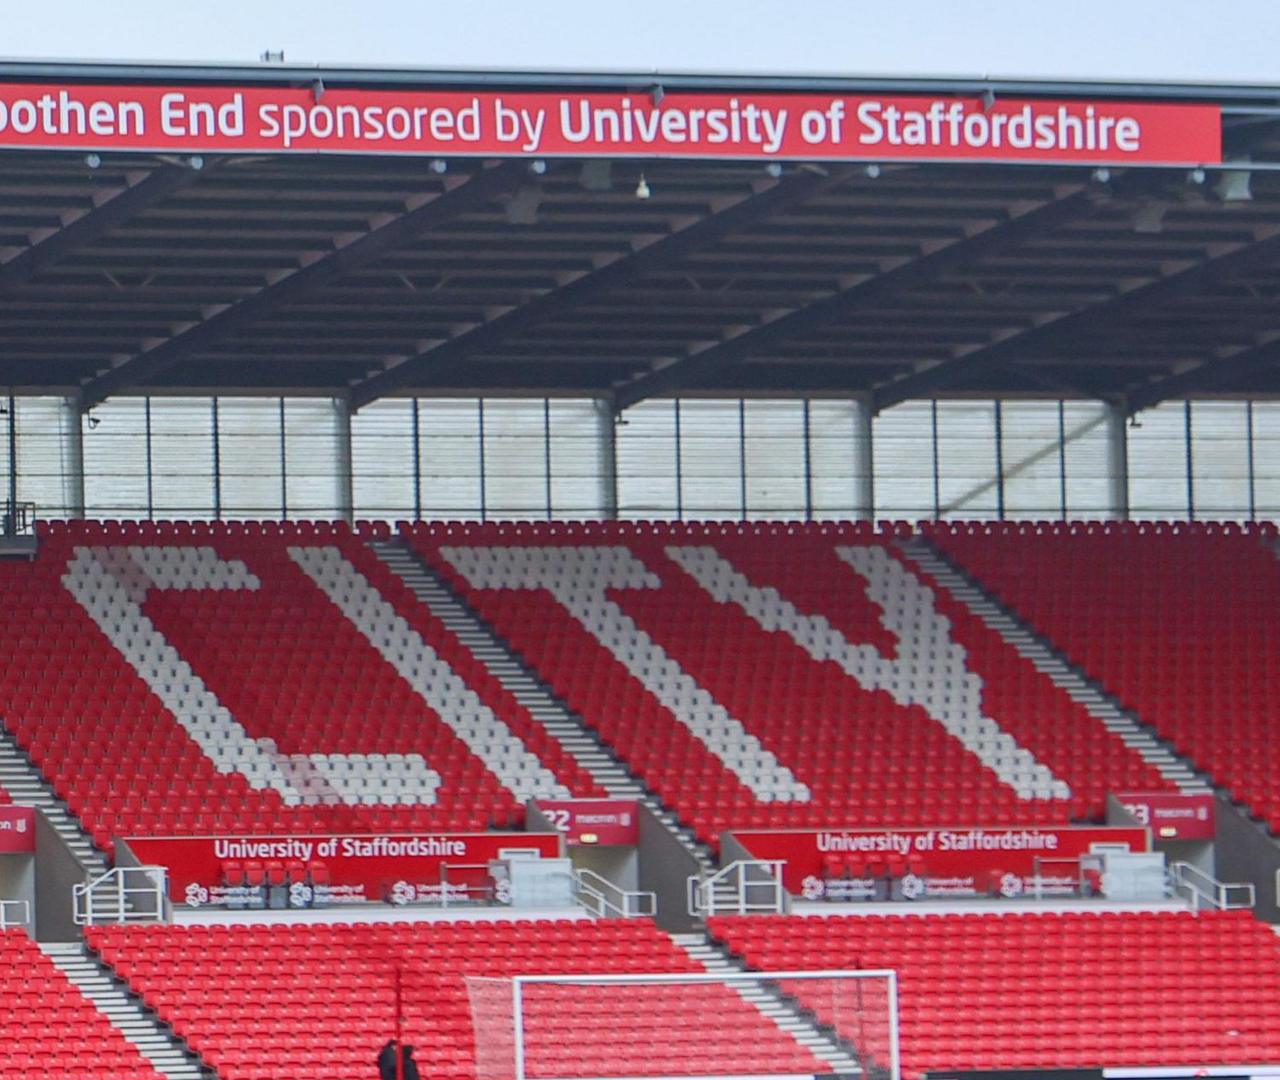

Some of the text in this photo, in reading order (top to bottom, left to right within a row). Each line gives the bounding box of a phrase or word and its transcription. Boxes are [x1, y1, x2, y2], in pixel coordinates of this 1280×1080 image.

[161, 92, 244, 138] End
[259, 97, 481, 149] sponsored
[495, 98, 545, 152] by
[560, 99, 787, 153] University
[801, 100, 844, 144] of
[858, 101, 1140, 152] Staffordshire
[61, 544, 1069, 808] CITY
[214, 837, 466, 862] University of Staffordshire
[816, 830, 1058, 855] University of Staffordshire
